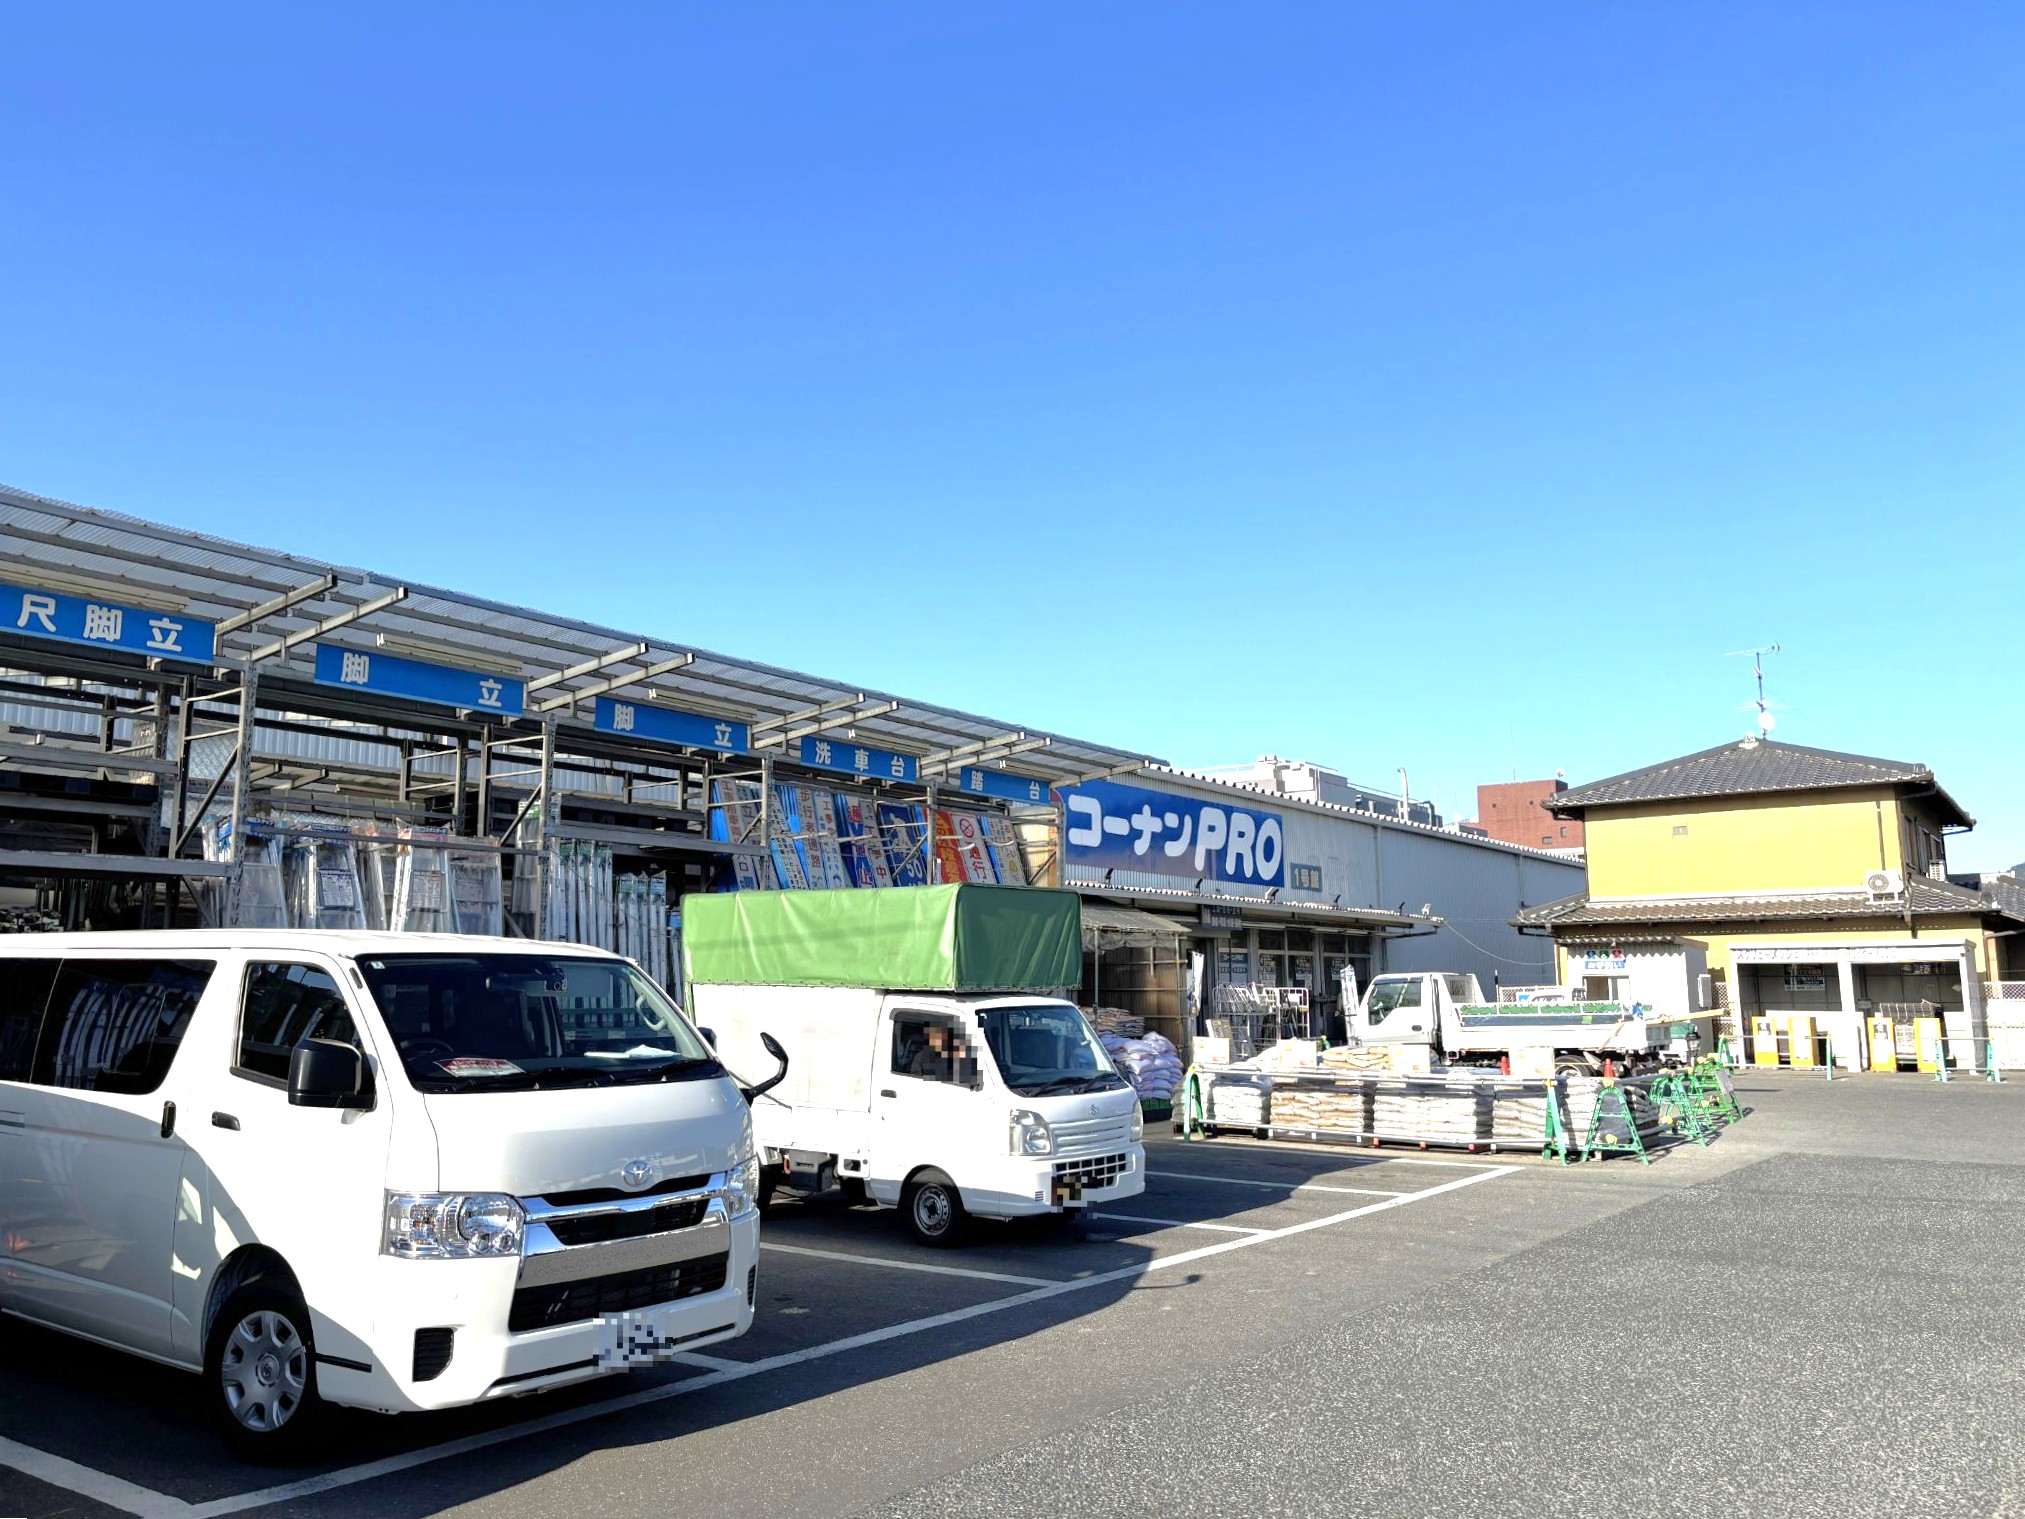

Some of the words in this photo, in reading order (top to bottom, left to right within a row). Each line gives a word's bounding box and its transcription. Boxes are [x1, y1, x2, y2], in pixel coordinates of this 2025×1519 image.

[17, 593, 183, 652] 尺脚立
[340, 652, 502, 707] 脚立
[613, 703, 732, 747] 脚立
[815, 741, 904, 777] 洗車台
[971, 771, 1041, 800] 踏台
[1295, 868, 1319, 888] 1号館
